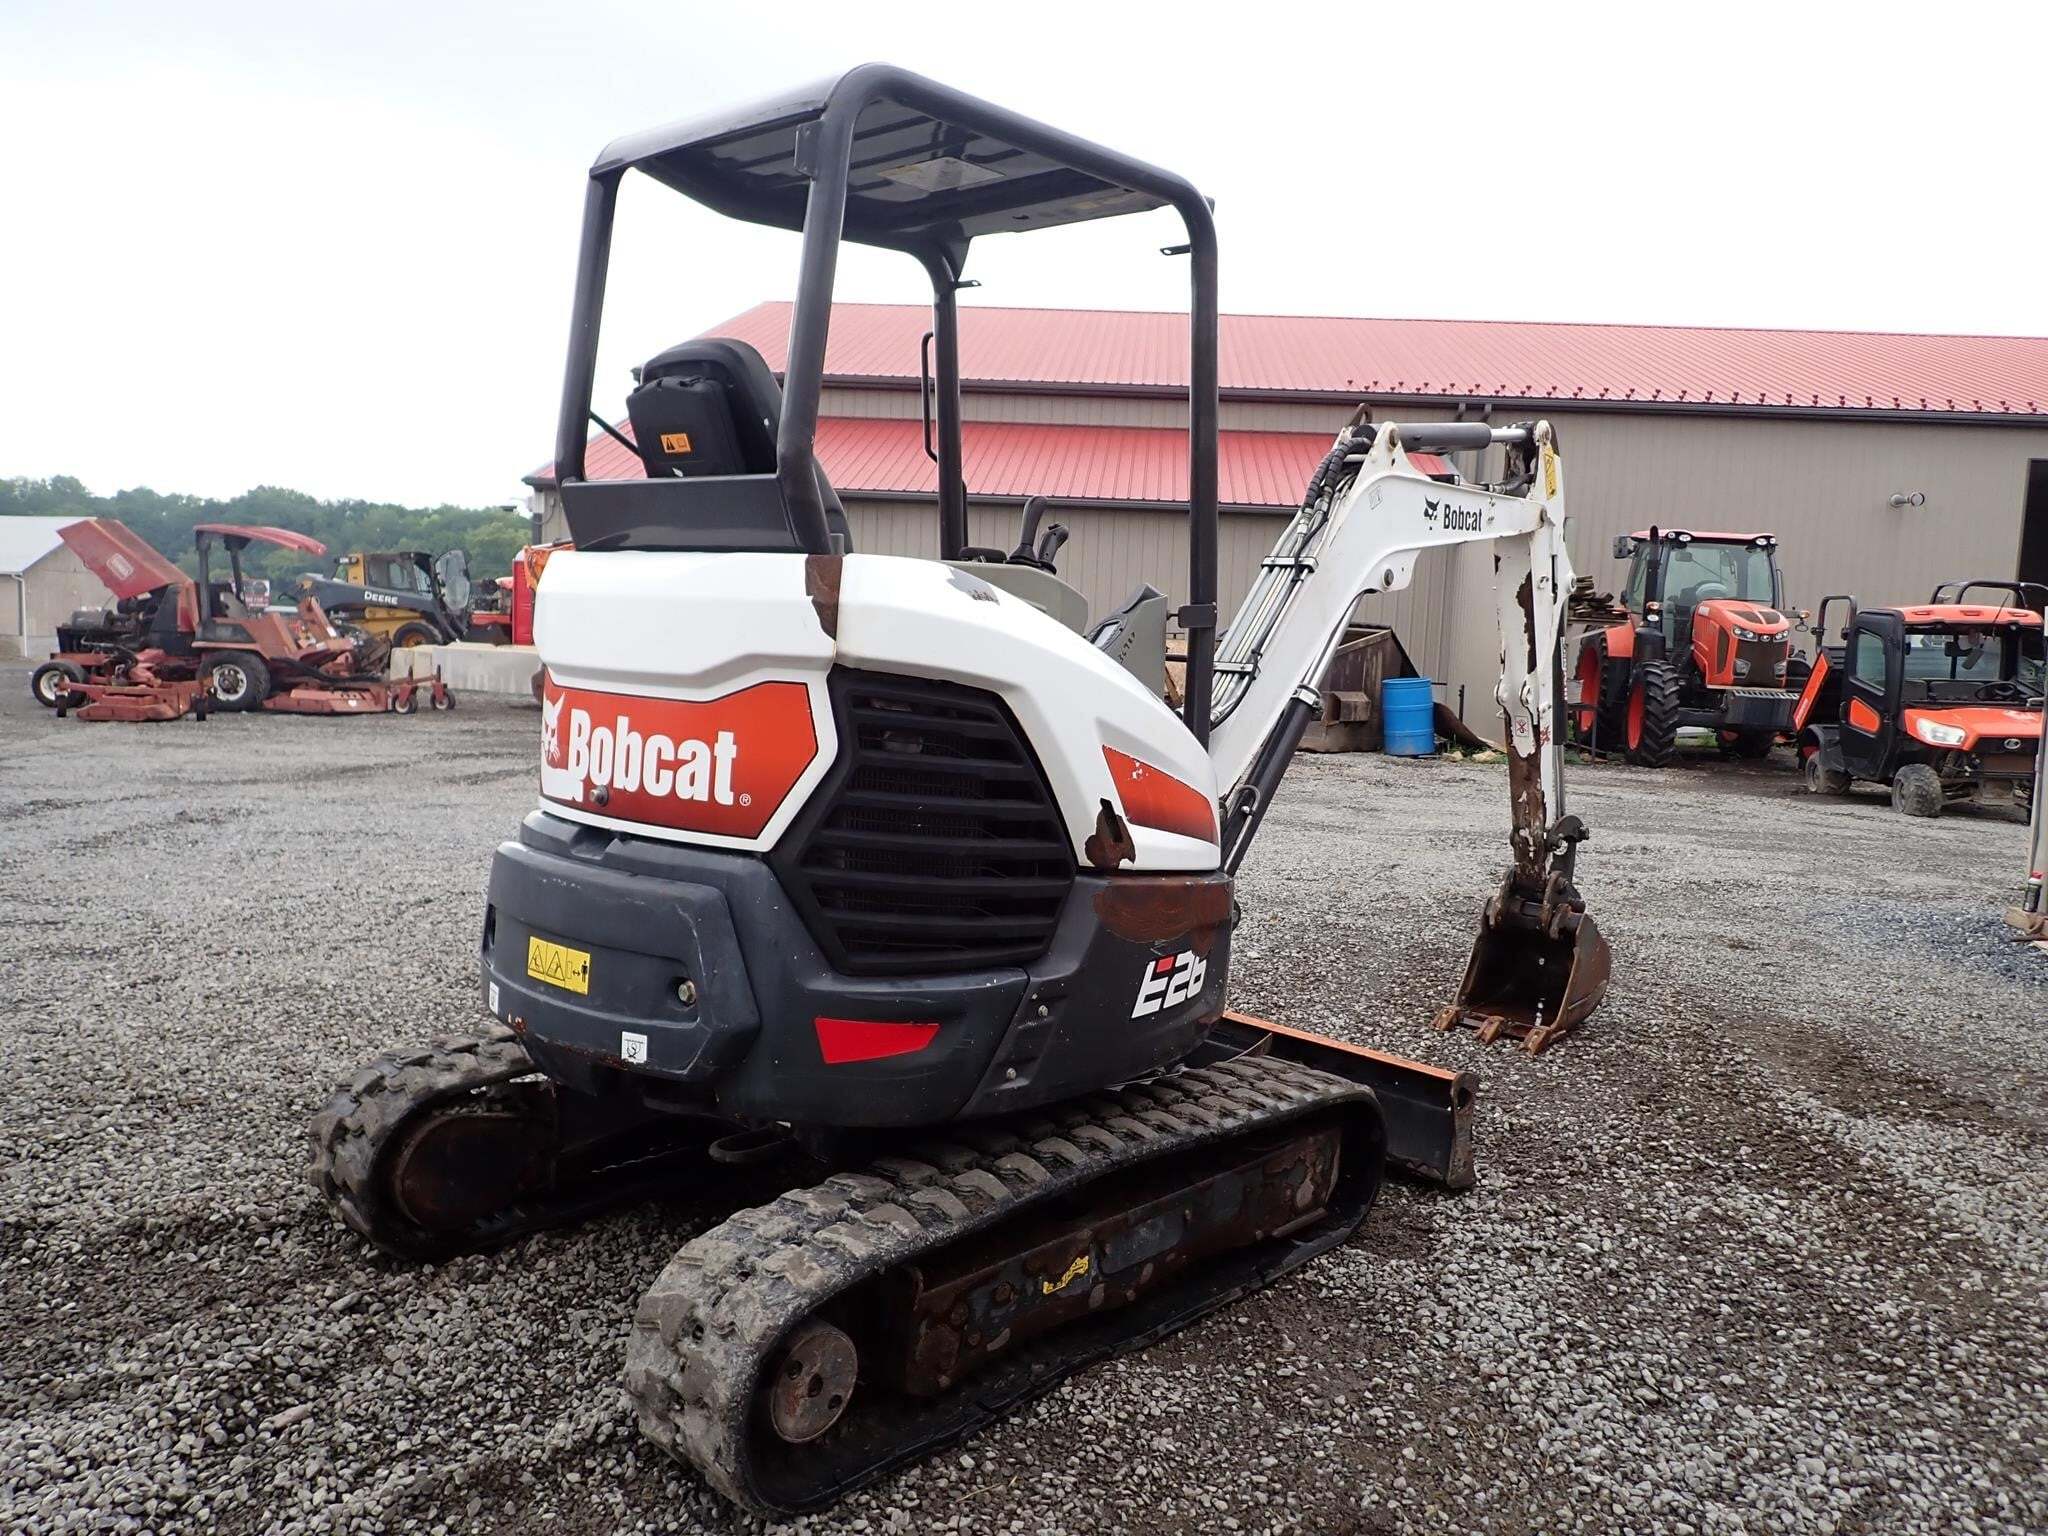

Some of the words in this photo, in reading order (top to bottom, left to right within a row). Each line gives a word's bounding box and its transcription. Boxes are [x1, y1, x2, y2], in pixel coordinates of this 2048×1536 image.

[1443, 504, 1482, 532] Bobcat
[364, 590, 399, 605] DEERE
[569, 708, 738, 806] Bobcat
